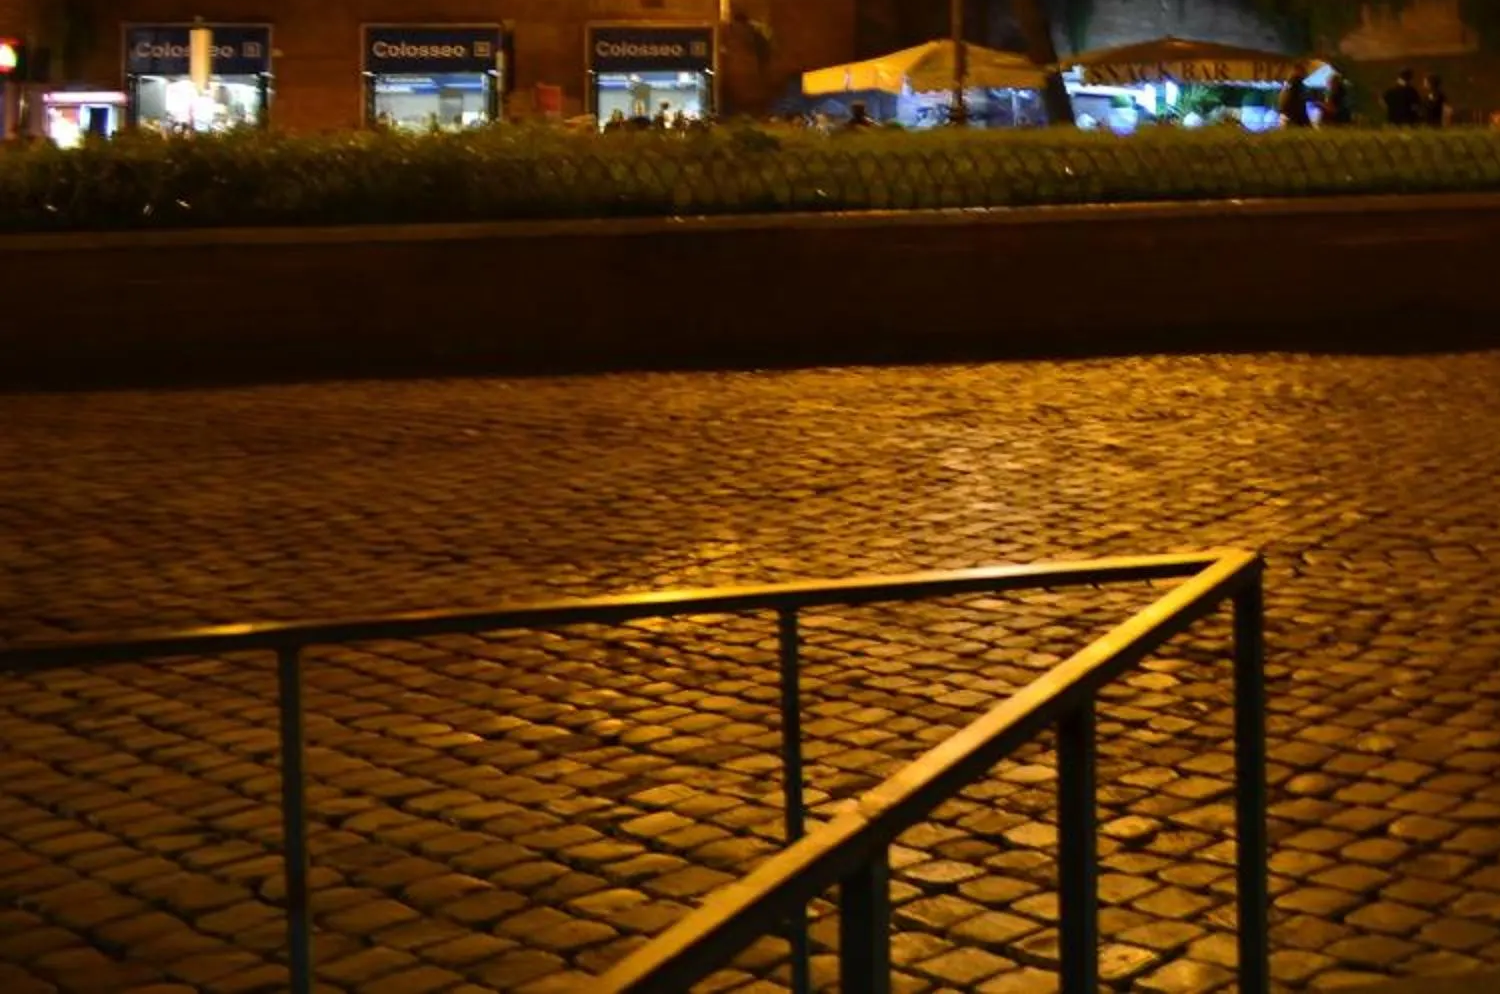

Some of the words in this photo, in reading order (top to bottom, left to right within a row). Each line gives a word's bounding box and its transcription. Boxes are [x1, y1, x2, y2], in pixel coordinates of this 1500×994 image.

[372, 40, 466, 58] Colosseo
[596, 40, 684, 57] Colosseo
[1091, 62, 1176, 82] SNACK
[1181, 61, 1230, 80] BAR
